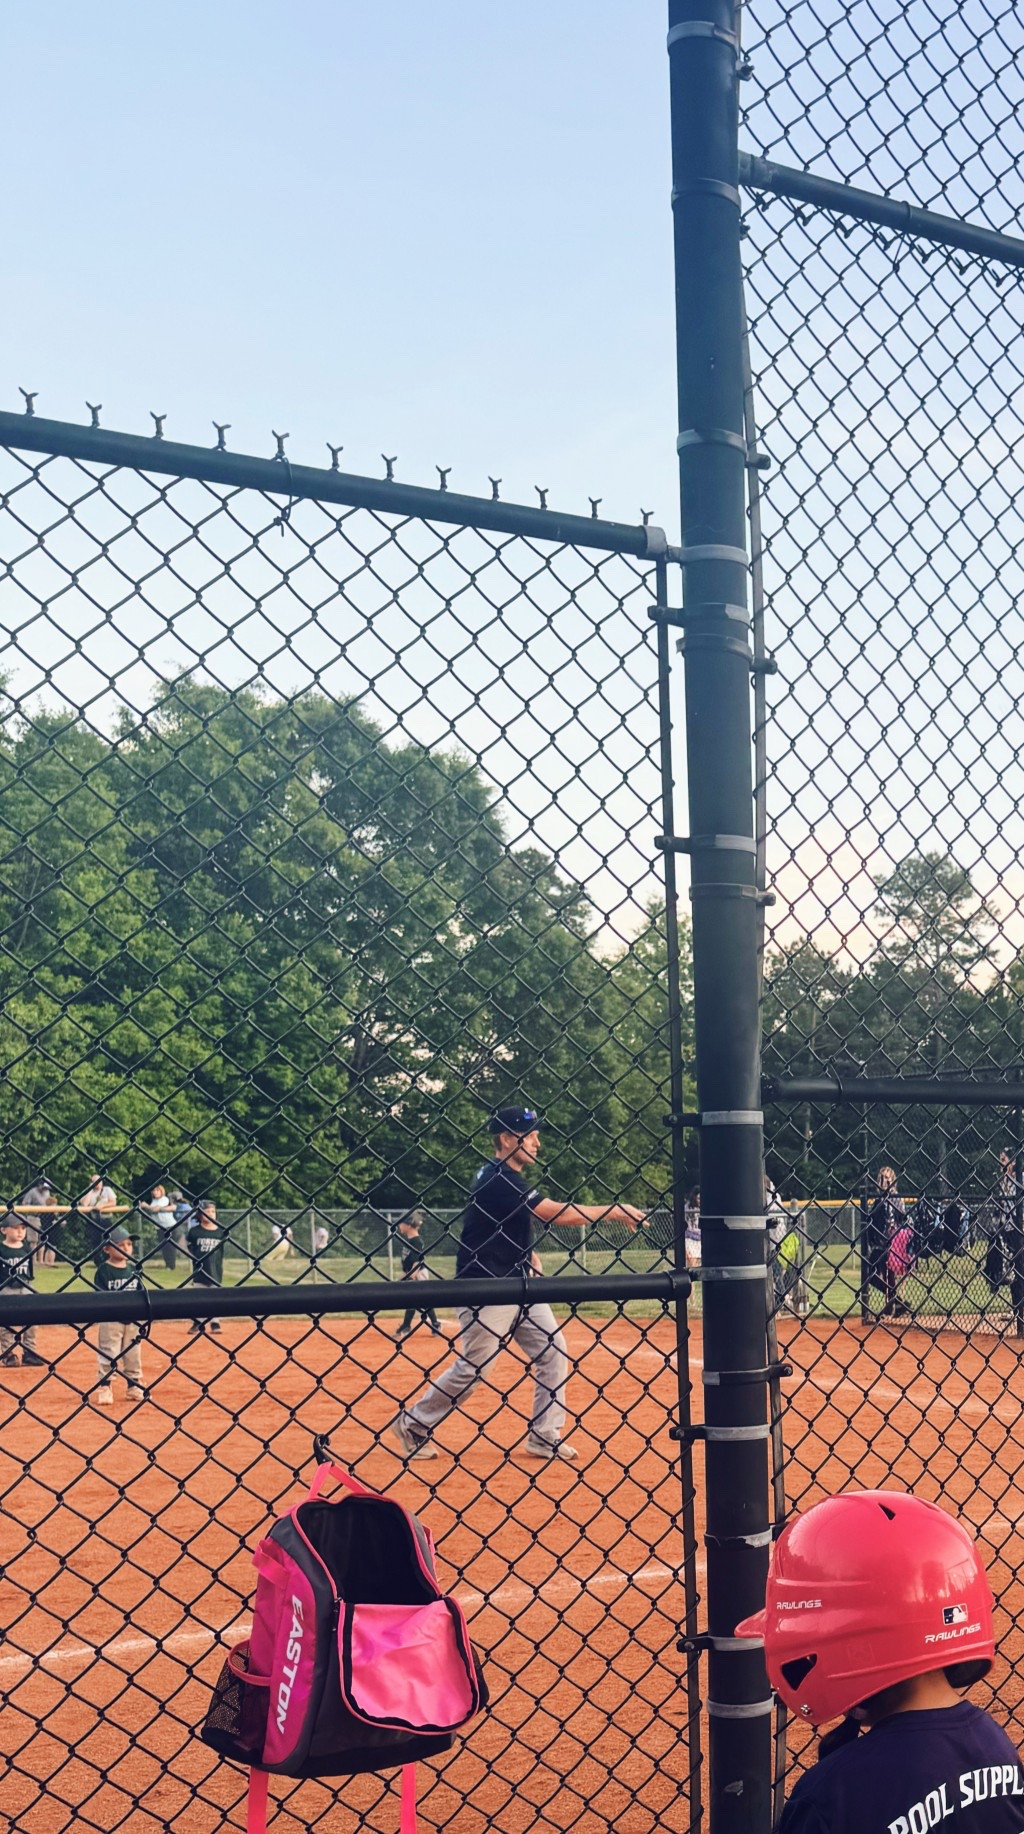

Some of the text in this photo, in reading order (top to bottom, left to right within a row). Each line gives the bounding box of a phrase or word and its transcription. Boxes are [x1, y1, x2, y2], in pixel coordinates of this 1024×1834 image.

[776, 1600, 822, 1610] RAWLINGS
[925, 1622, 981, 1643] RAWLINGS
[277, 1594, 304, 1734] EASTON
[887, 1783, 955, 1834] POOL
